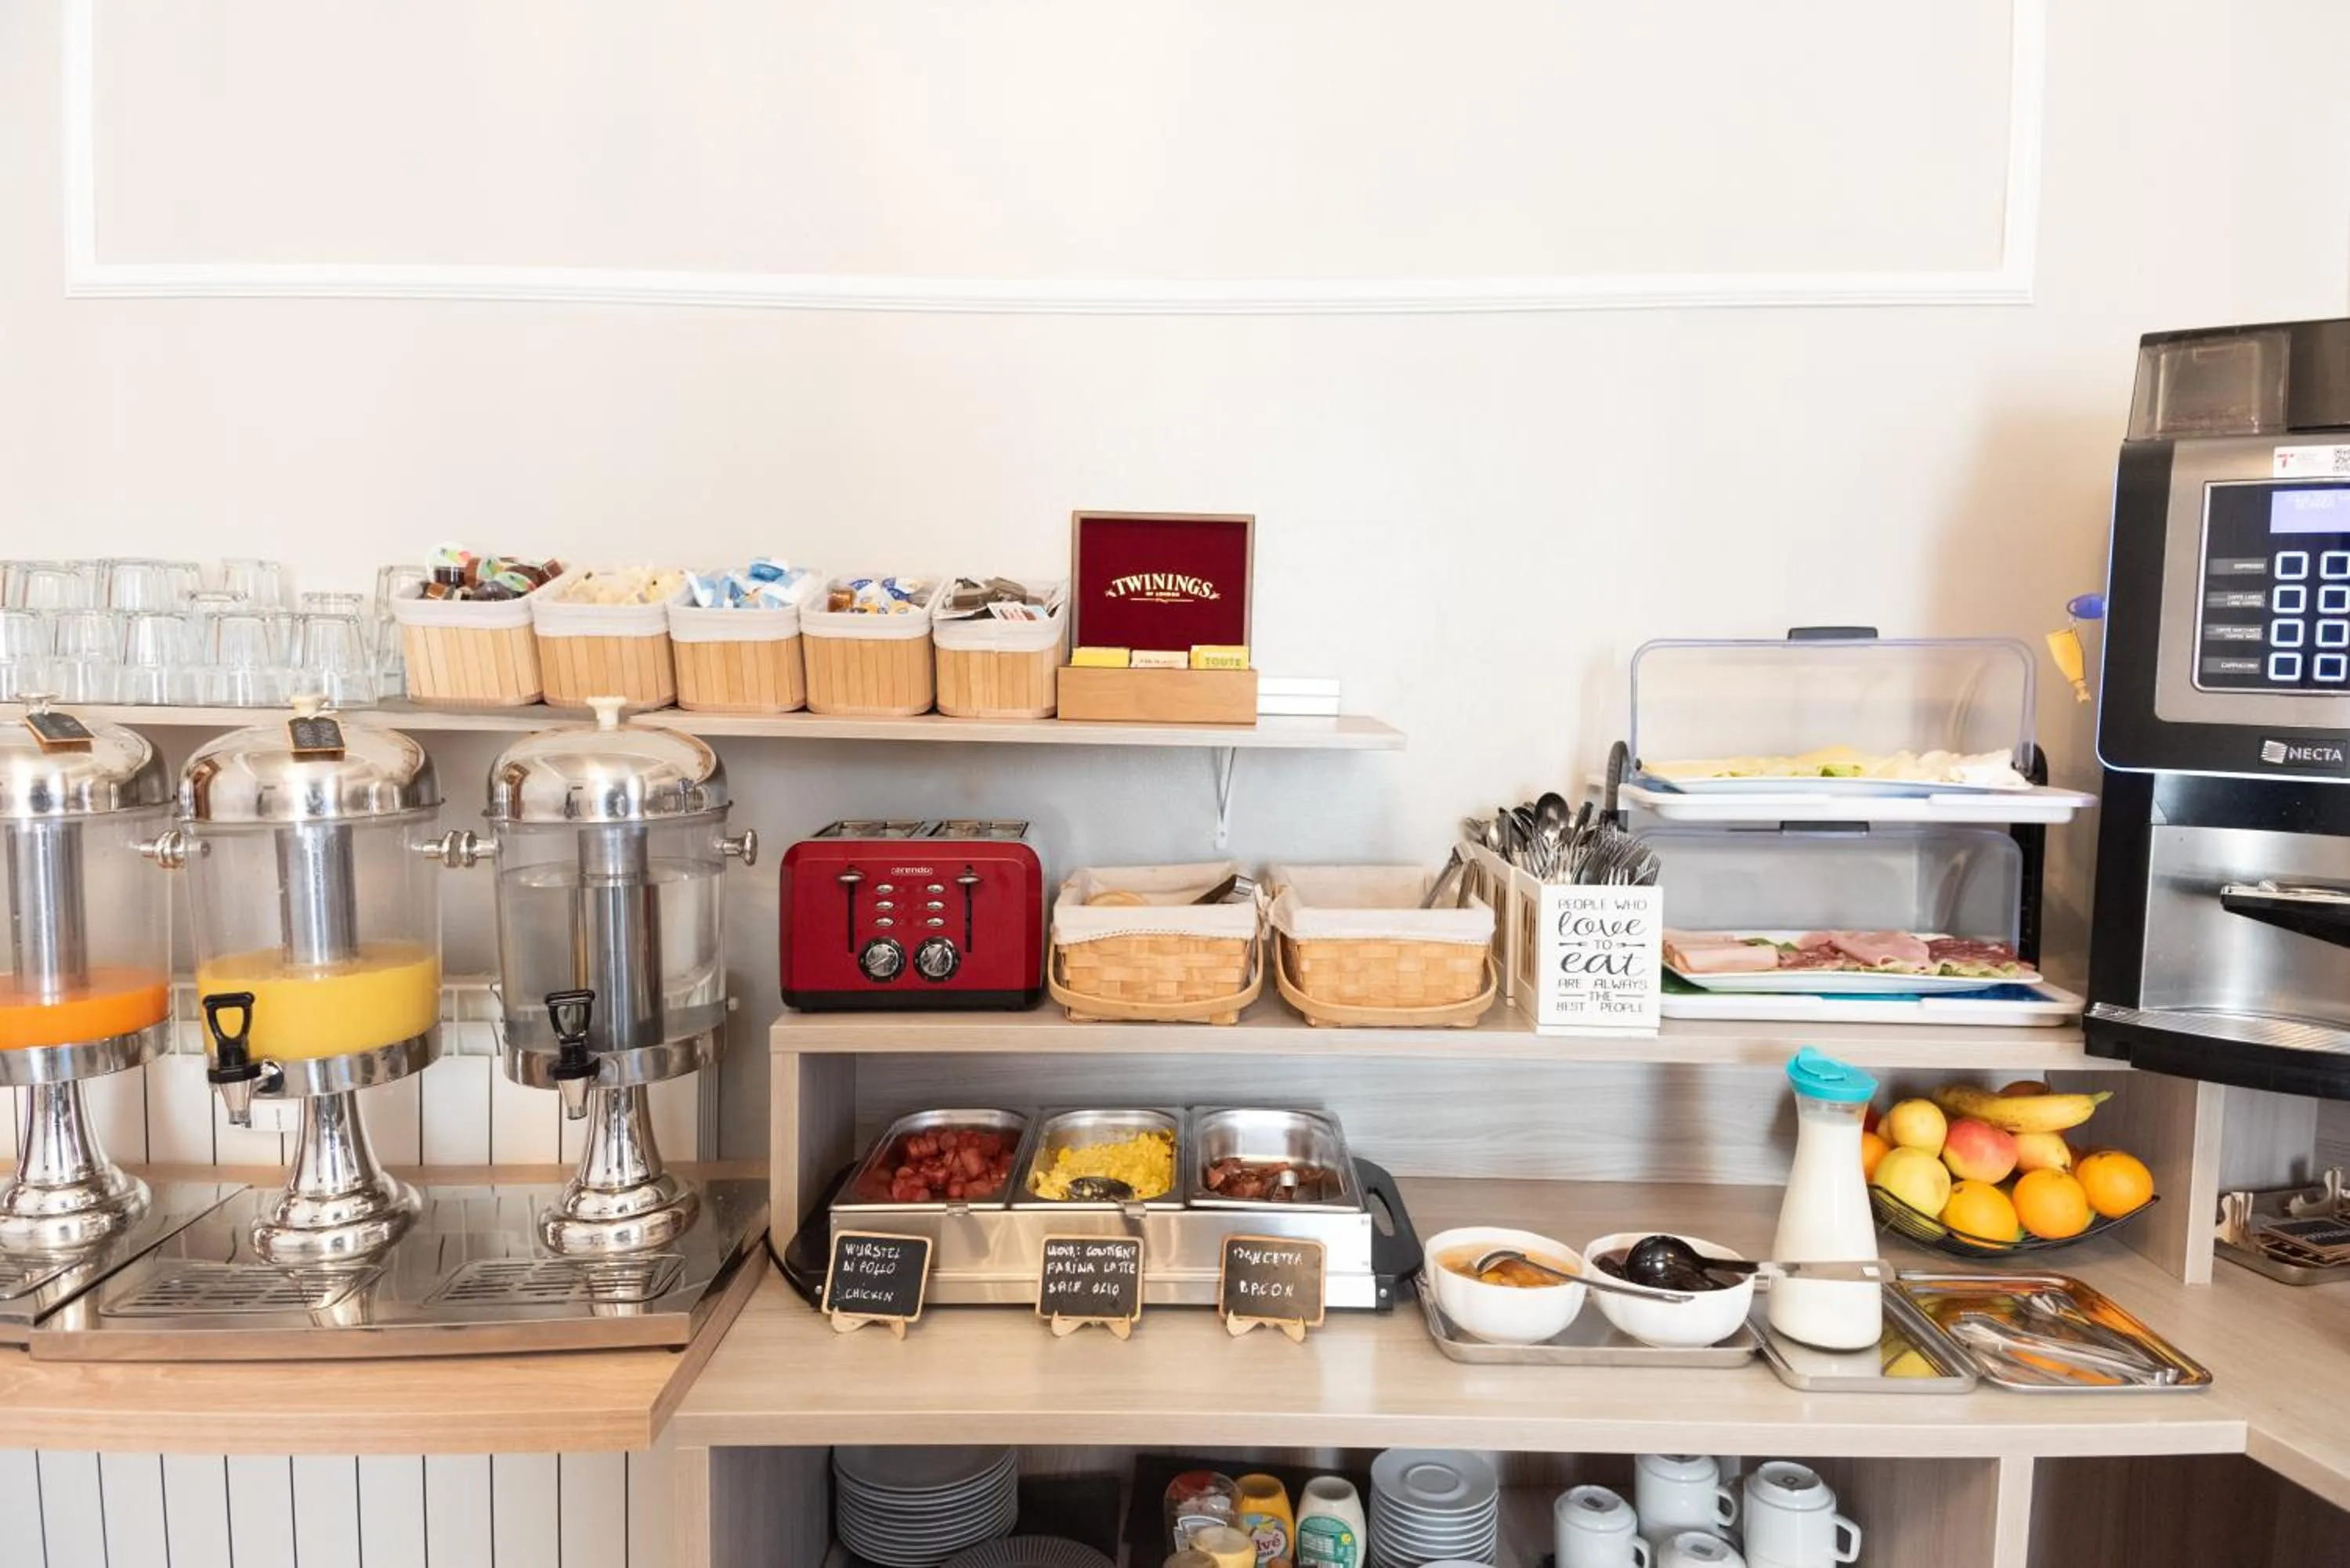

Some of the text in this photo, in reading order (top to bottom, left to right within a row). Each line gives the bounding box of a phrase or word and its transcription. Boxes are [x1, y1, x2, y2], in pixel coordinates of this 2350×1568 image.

[1112, 573, 1213, 598] TWININGS
[2288, 746, 2342, 761] NECTA
[1558, 898, 1647, 909] PEOPLE WHO
[1558, 911, 1647, 937] love
[1593, 940, 1613, 950] TO
[1560, 952, 1646, 976] eat
[1558, 978, 1648, 989] ARE ALWAYS
[1589, 991, 1612, 1001] THE
[1556, 1002, 1643, 1012] BEST PEOPLE
[1047, 1261, 1136, 1275] FARINA LATTE
[845, 1288, 894, 1302] CHICKEN
[1239, 1280, 1294, 1297] BACON
